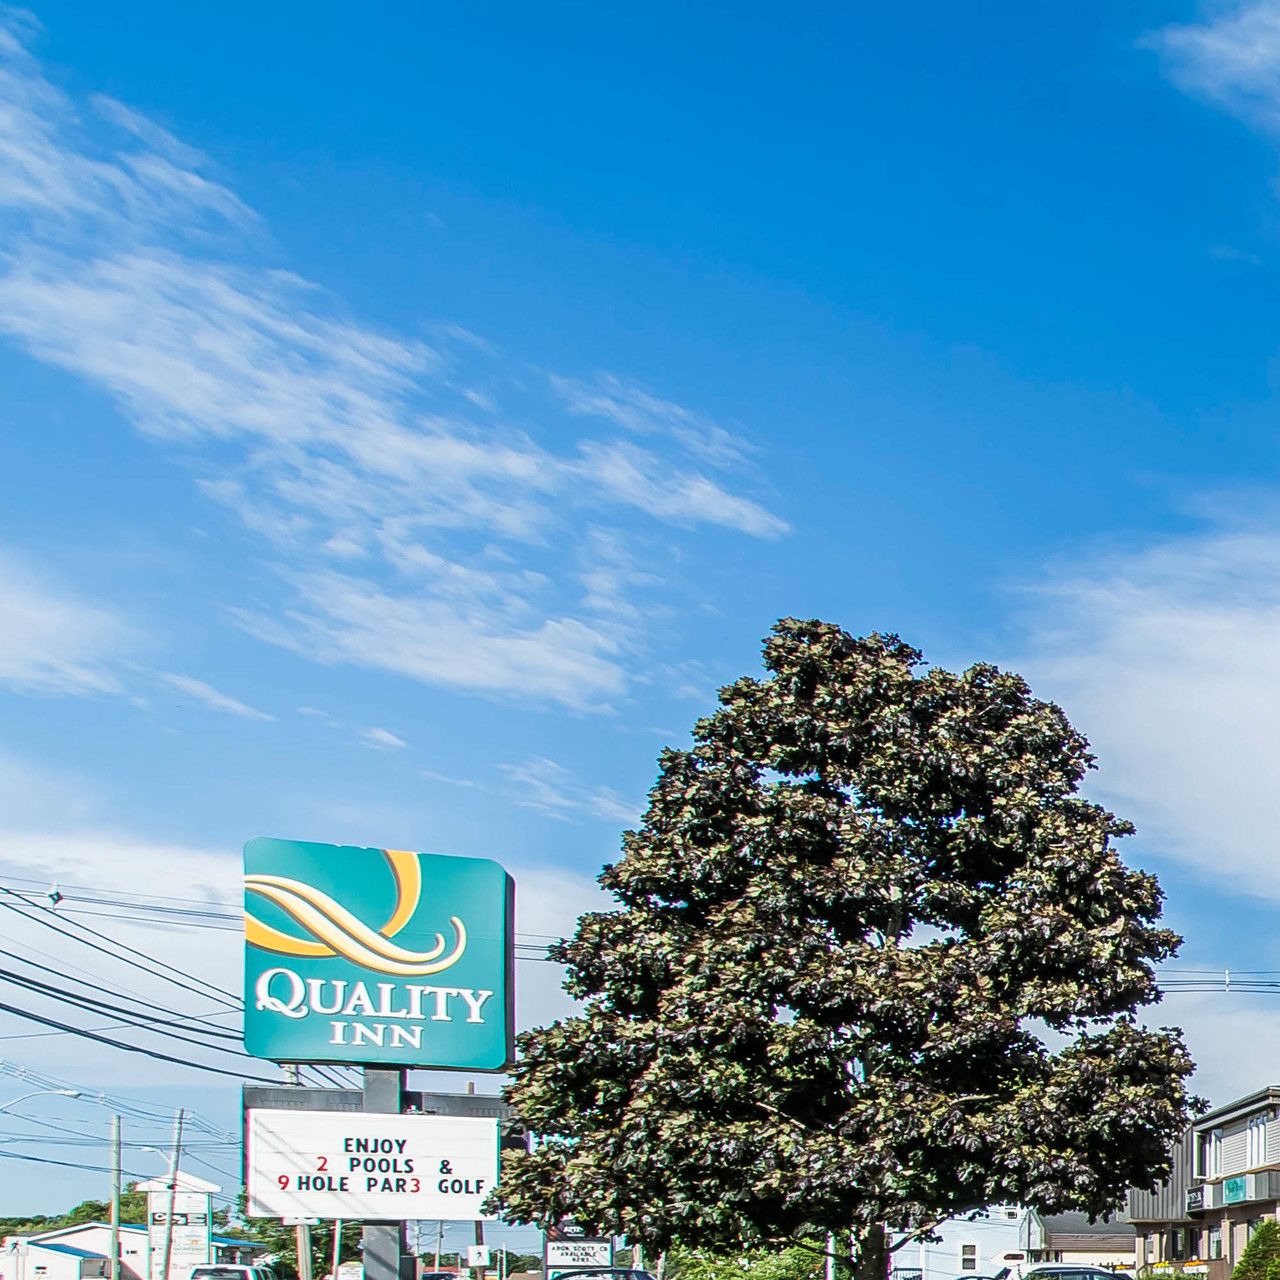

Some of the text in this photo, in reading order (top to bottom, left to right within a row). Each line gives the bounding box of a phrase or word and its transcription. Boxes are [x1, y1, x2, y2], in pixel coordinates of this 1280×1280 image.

[255, 967, 494, 1024] QUALITY
[329, 1021, 424, 1049] INN
[344, 1138, 407, 1155] ENJOY
[316, 1156, 453, 1175] 2 POOLS &
[277, 1175, 290, 1191] 9
[297, 1175, 349, 1192] HOLE
[438, 1178, 485, 1195] GOLF
